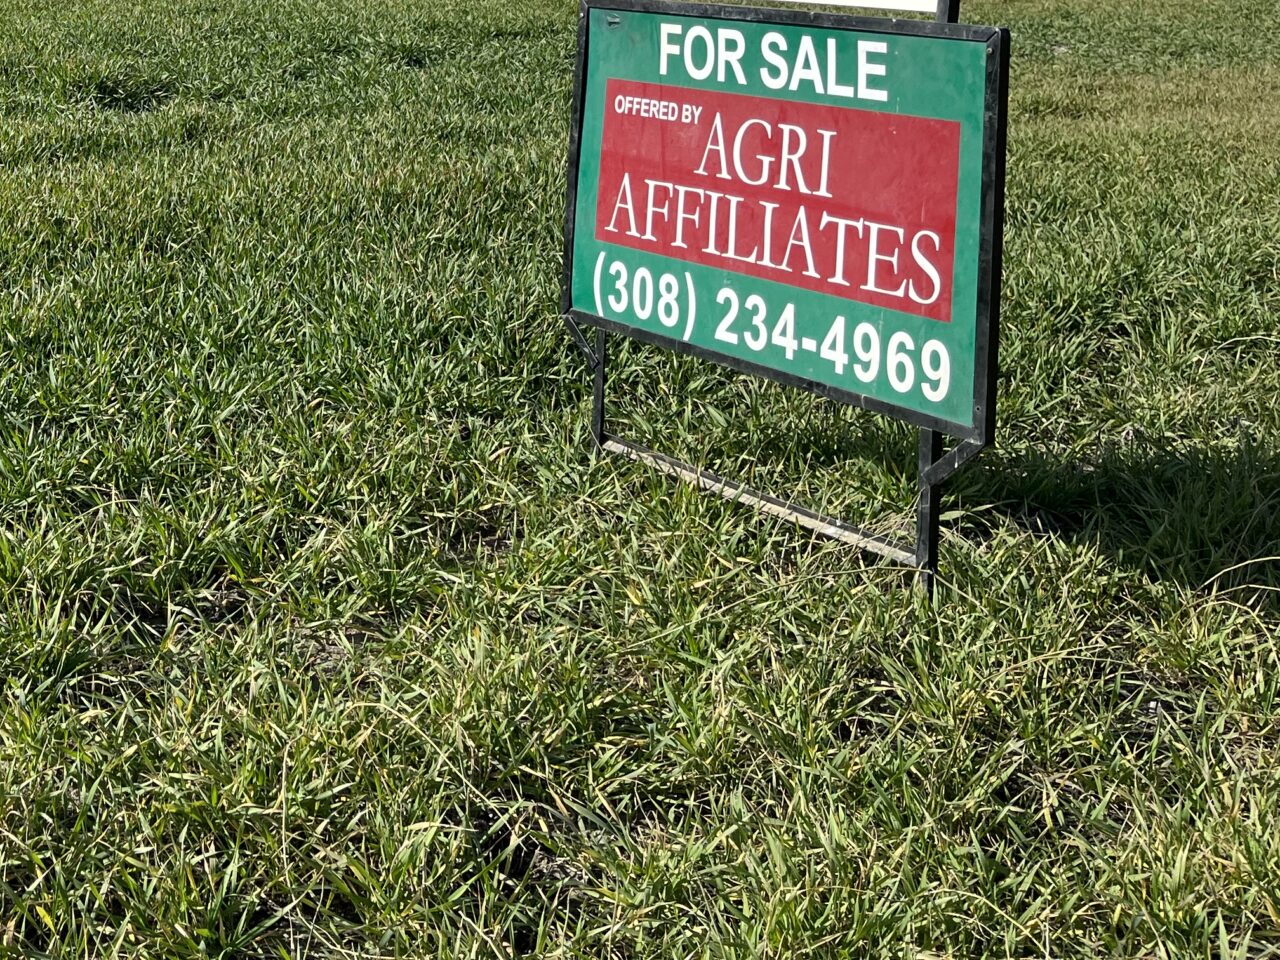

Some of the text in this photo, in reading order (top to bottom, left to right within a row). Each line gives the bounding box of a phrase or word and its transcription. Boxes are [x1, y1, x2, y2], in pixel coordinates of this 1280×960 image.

[659, 22, 889, 102] FOR SALE
[614, 94, 703, 125] OFFERED BY
[693, 111, 838, 198] AGRI
[604, 172, 942, 305] AFFILIATES
[593, 250, 952, 403] (308) 234-4969
